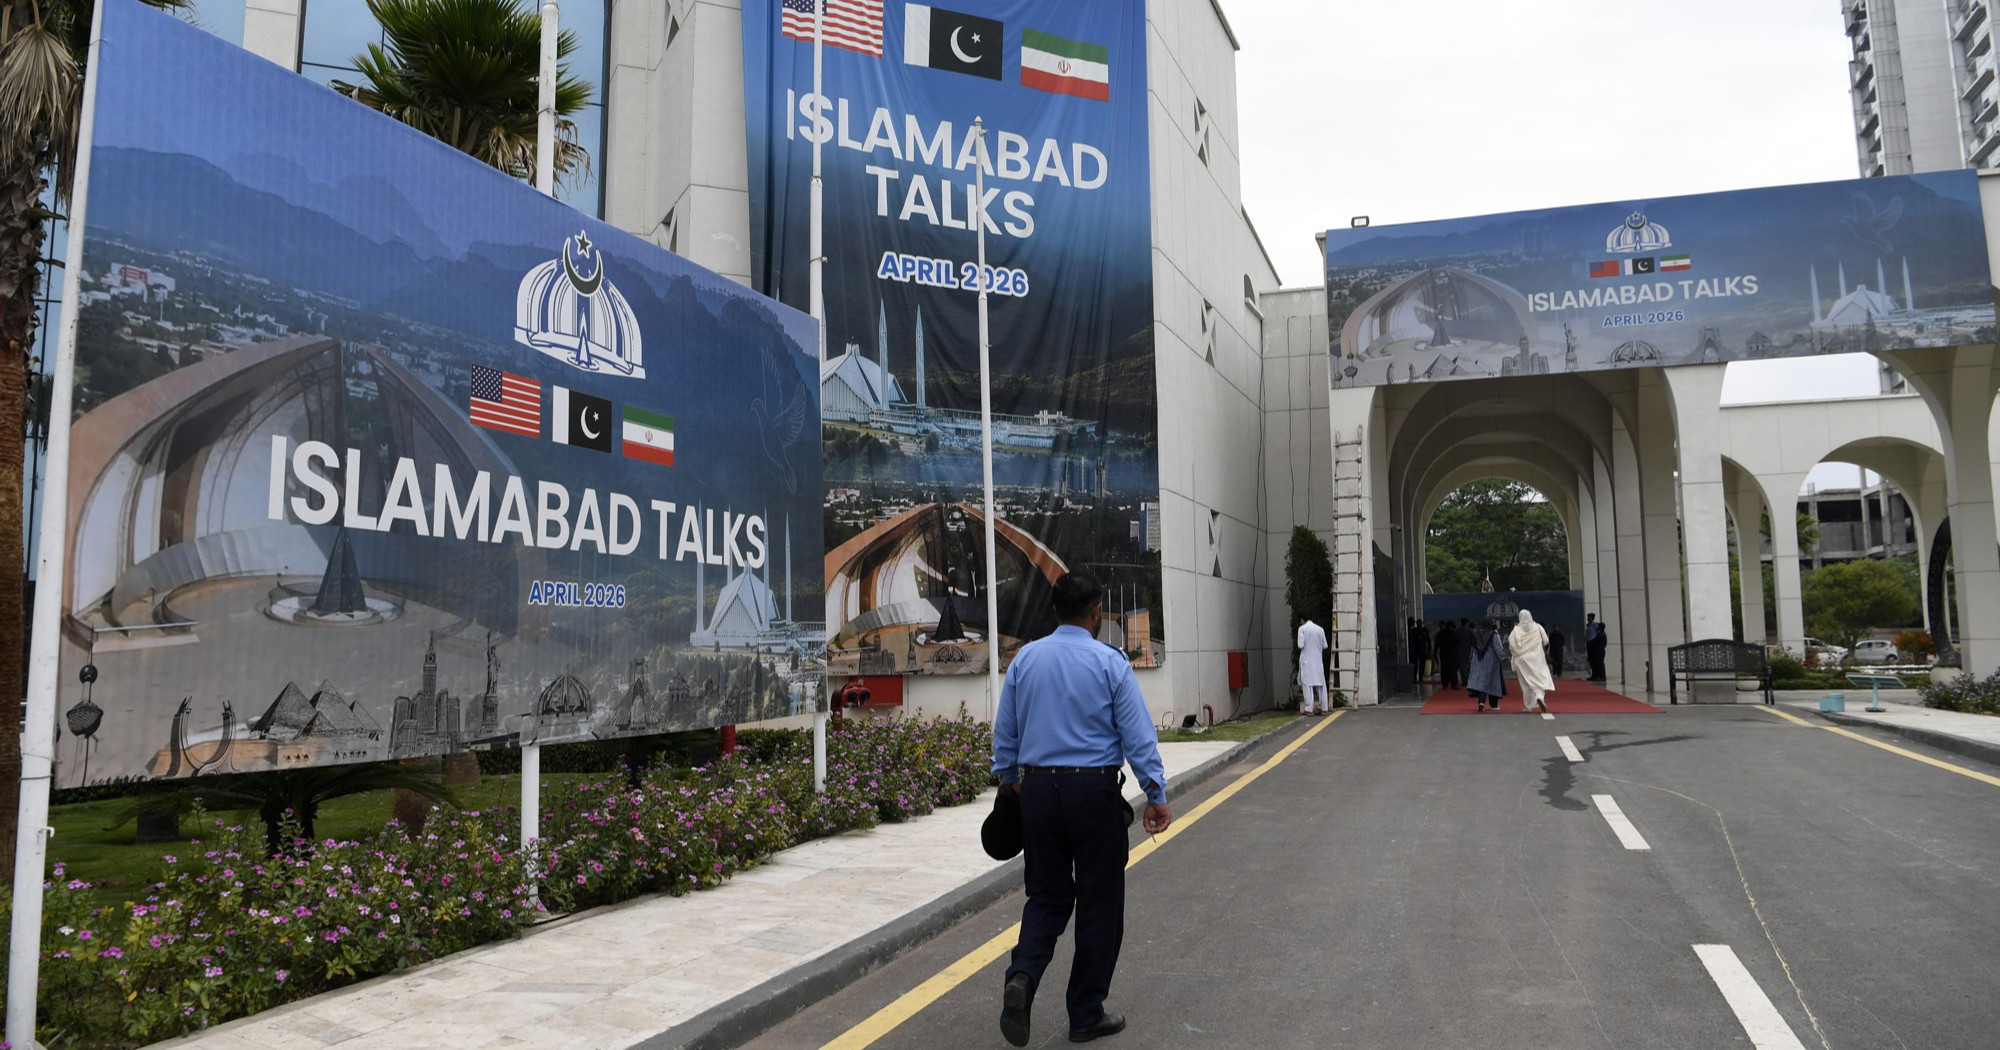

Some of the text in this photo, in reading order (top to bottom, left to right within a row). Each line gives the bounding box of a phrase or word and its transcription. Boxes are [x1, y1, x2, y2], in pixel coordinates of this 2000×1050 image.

[788, 89, 1107, 189] ISLAMABAD
[866, 165, 1034, 238] TALKS
[877, 251, 1029, 297] APRIL 2026
[1528, 275, 1758, 312] ISLAMABAD TALKS
[1603, 310, 1684, 328] APRIL 2026
[268, 434, 766, 569] ISLAMABAD TALKS
[528, 580, 625, 608] APRIL 2026
